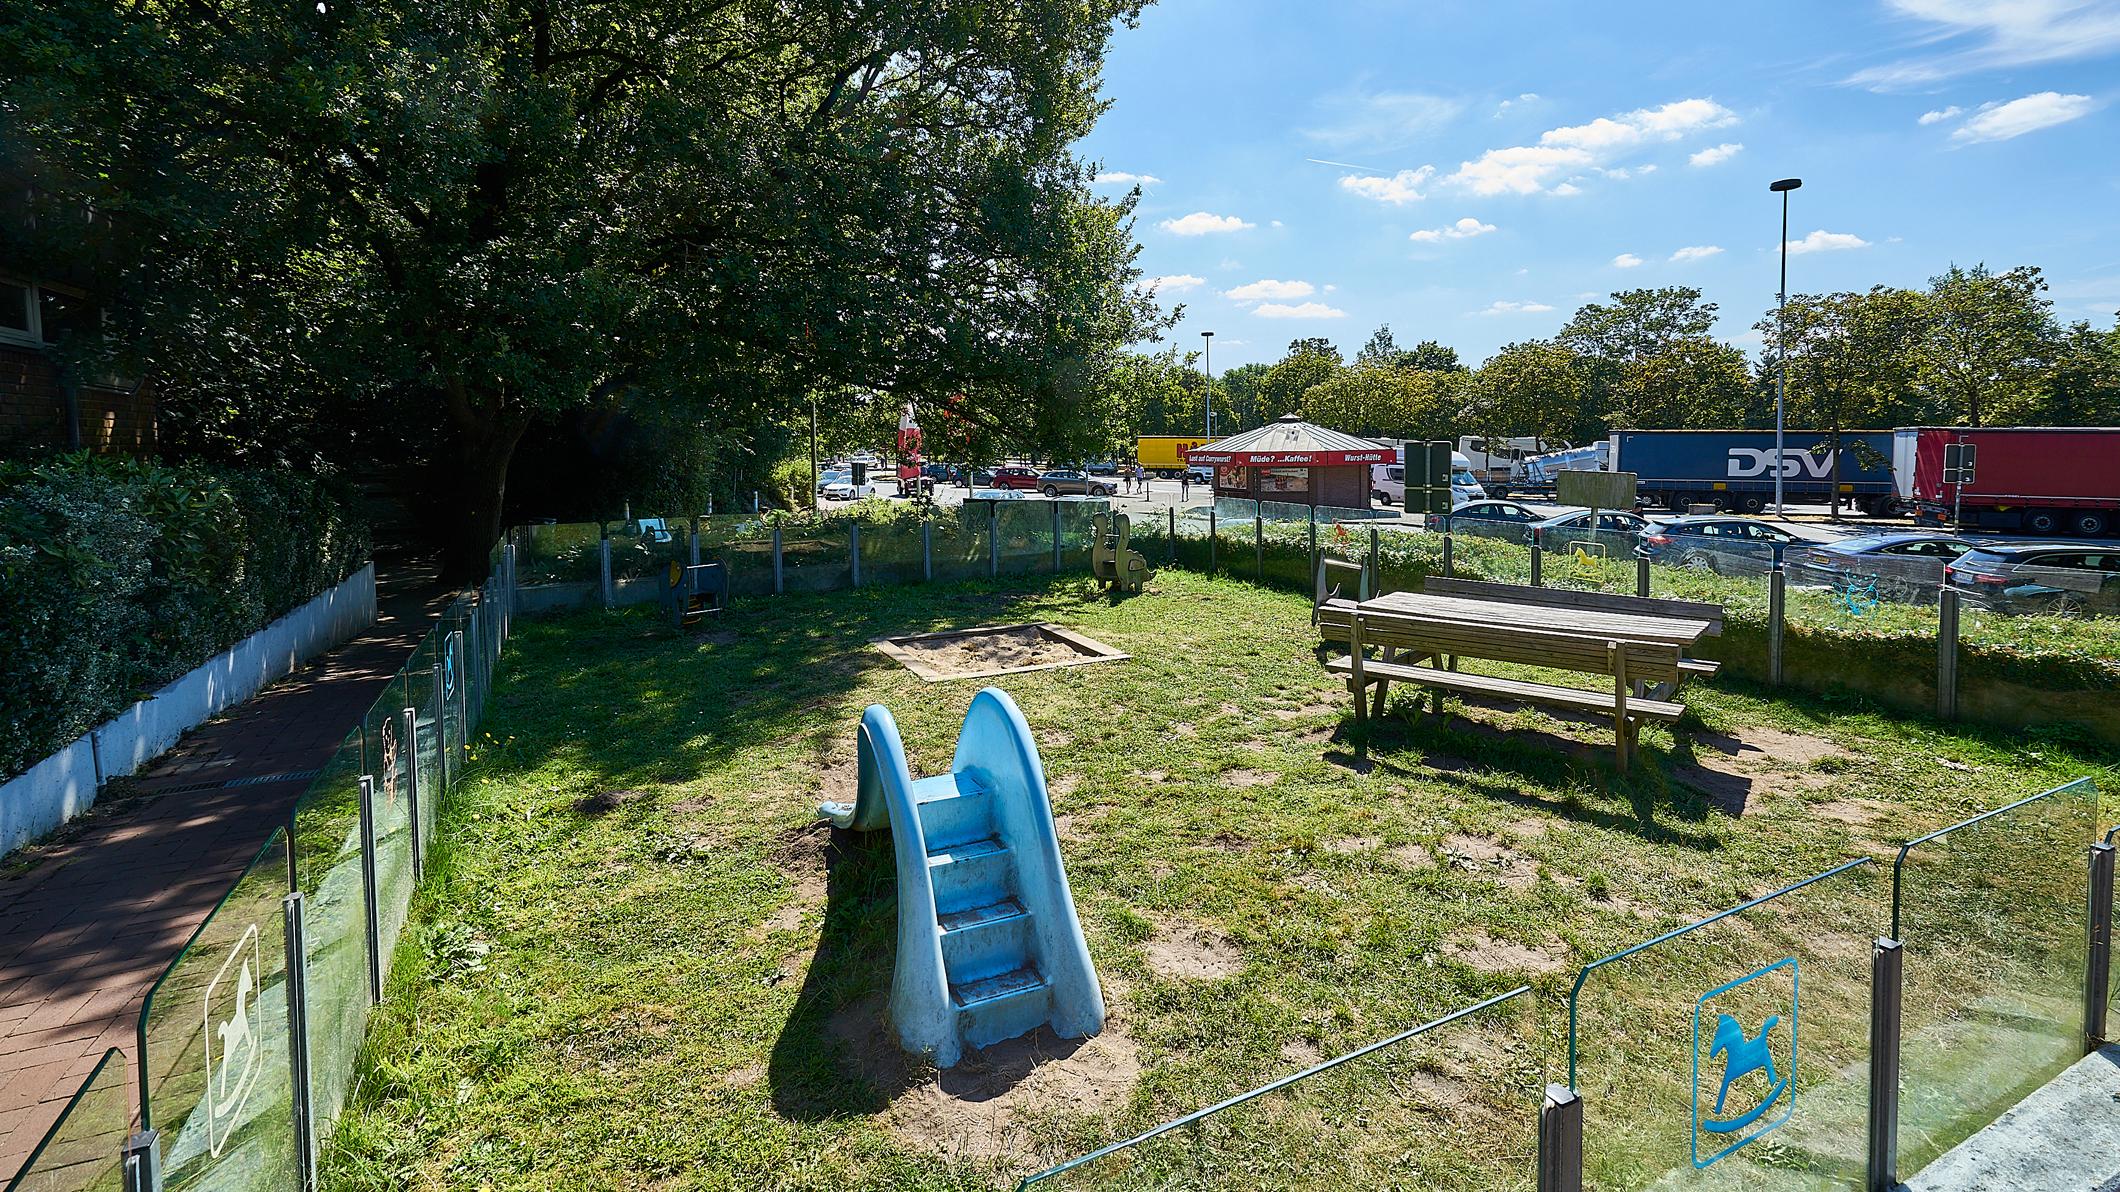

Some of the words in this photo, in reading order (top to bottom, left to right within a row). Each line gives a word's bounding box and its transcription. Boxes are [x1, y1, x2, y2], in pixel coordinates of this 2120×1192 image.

[1249, 455, 1276, 463] Müde?
[1344, 453, 1382, 462] Wurst-Hütte
[1727, 447, 1843, 478] DSV
